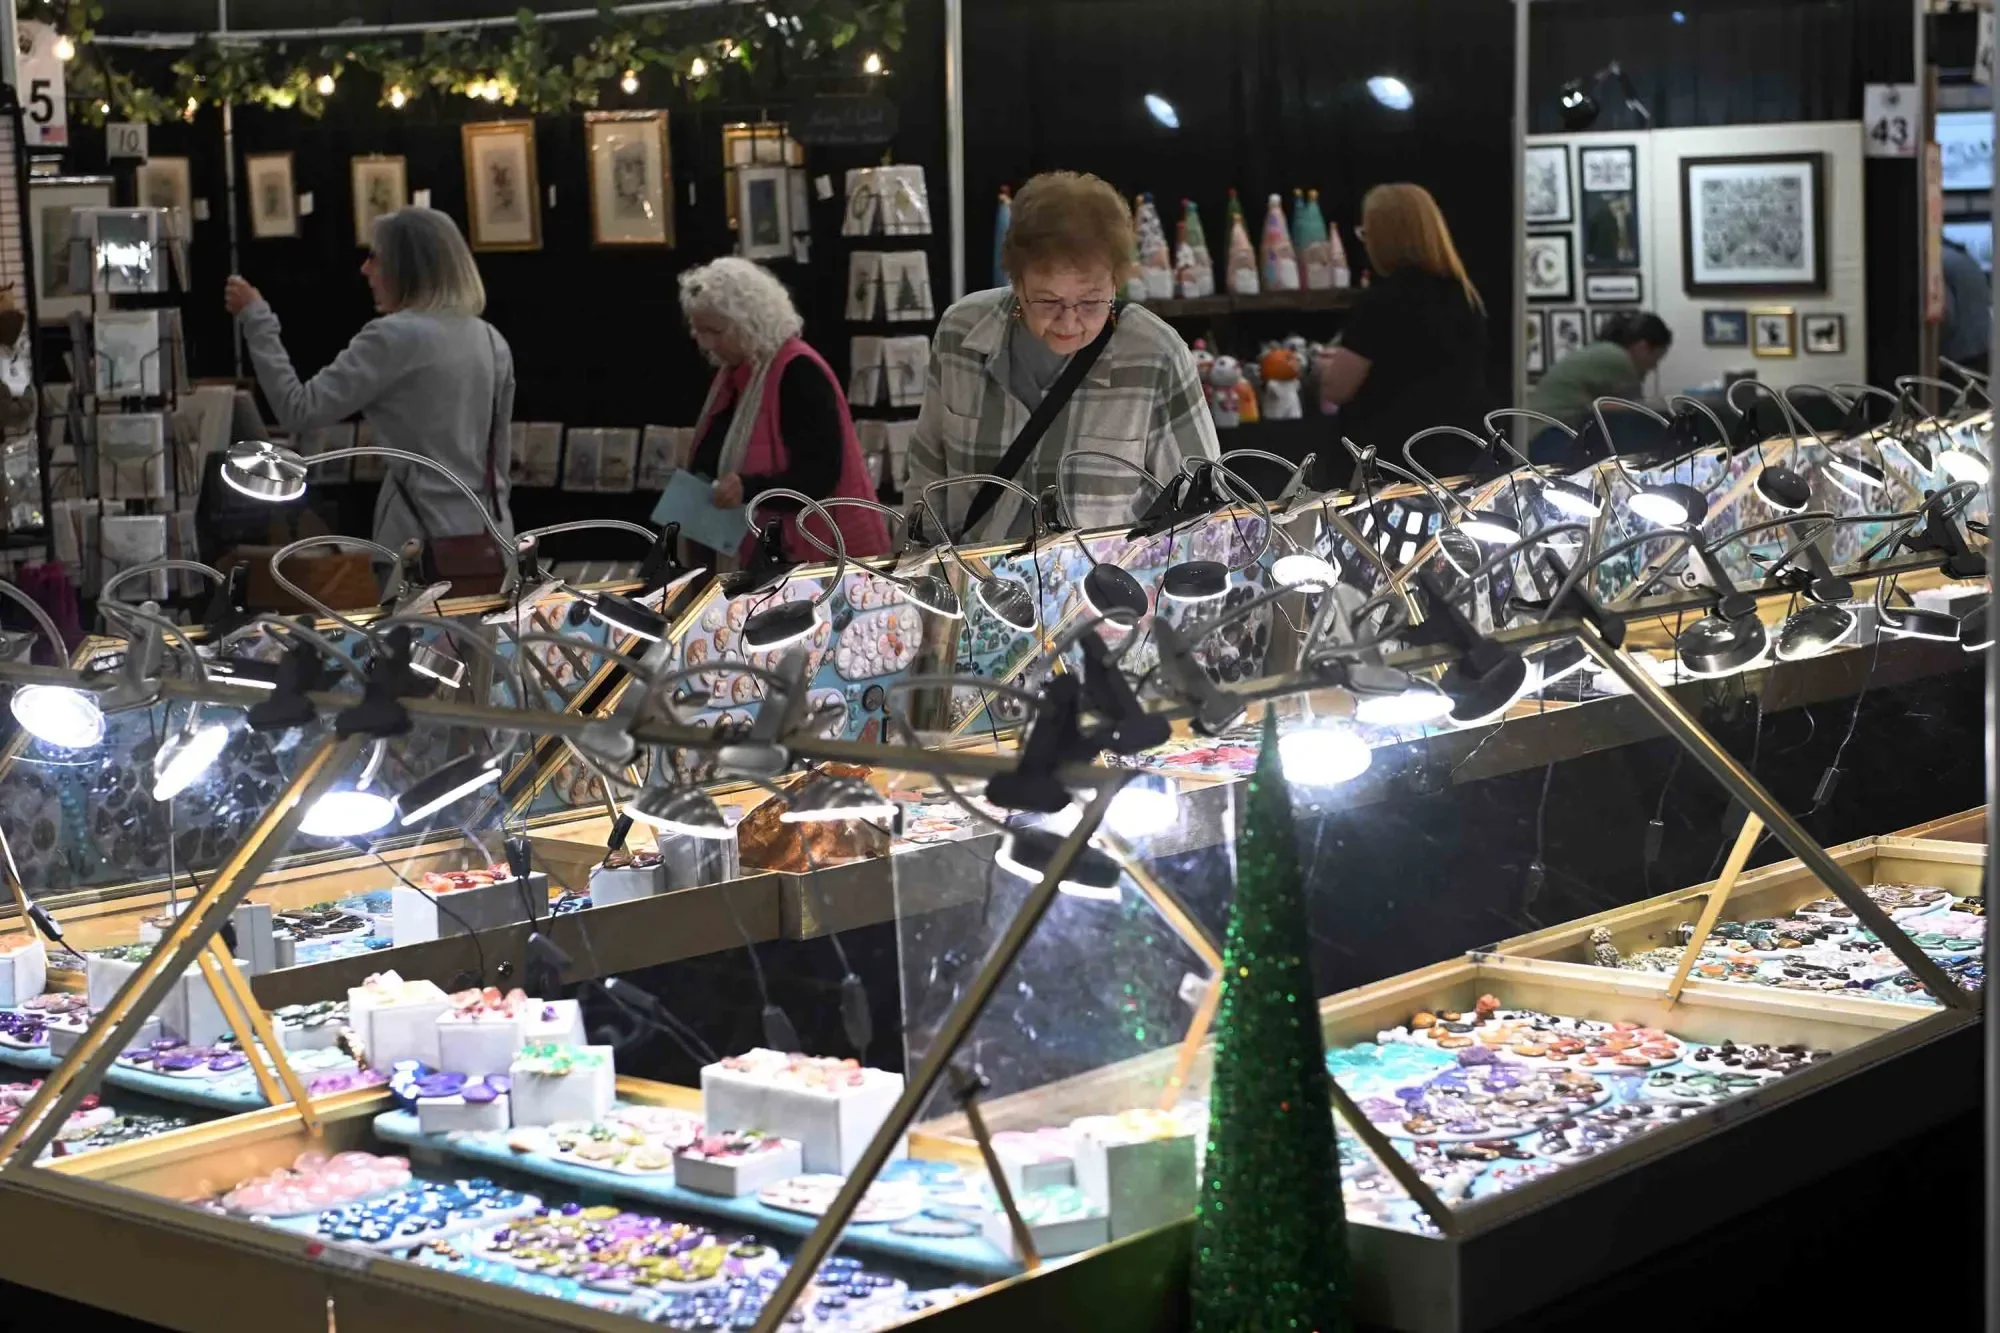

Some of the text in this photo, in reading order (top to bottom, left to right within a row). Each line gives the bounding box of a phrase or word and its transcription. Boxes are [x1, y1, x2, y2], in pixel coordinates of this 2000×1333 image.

[22, 79, 54, 123] 5
[117, 129, 140, 152] 10
[1871, 116, 1908, 146] 43
